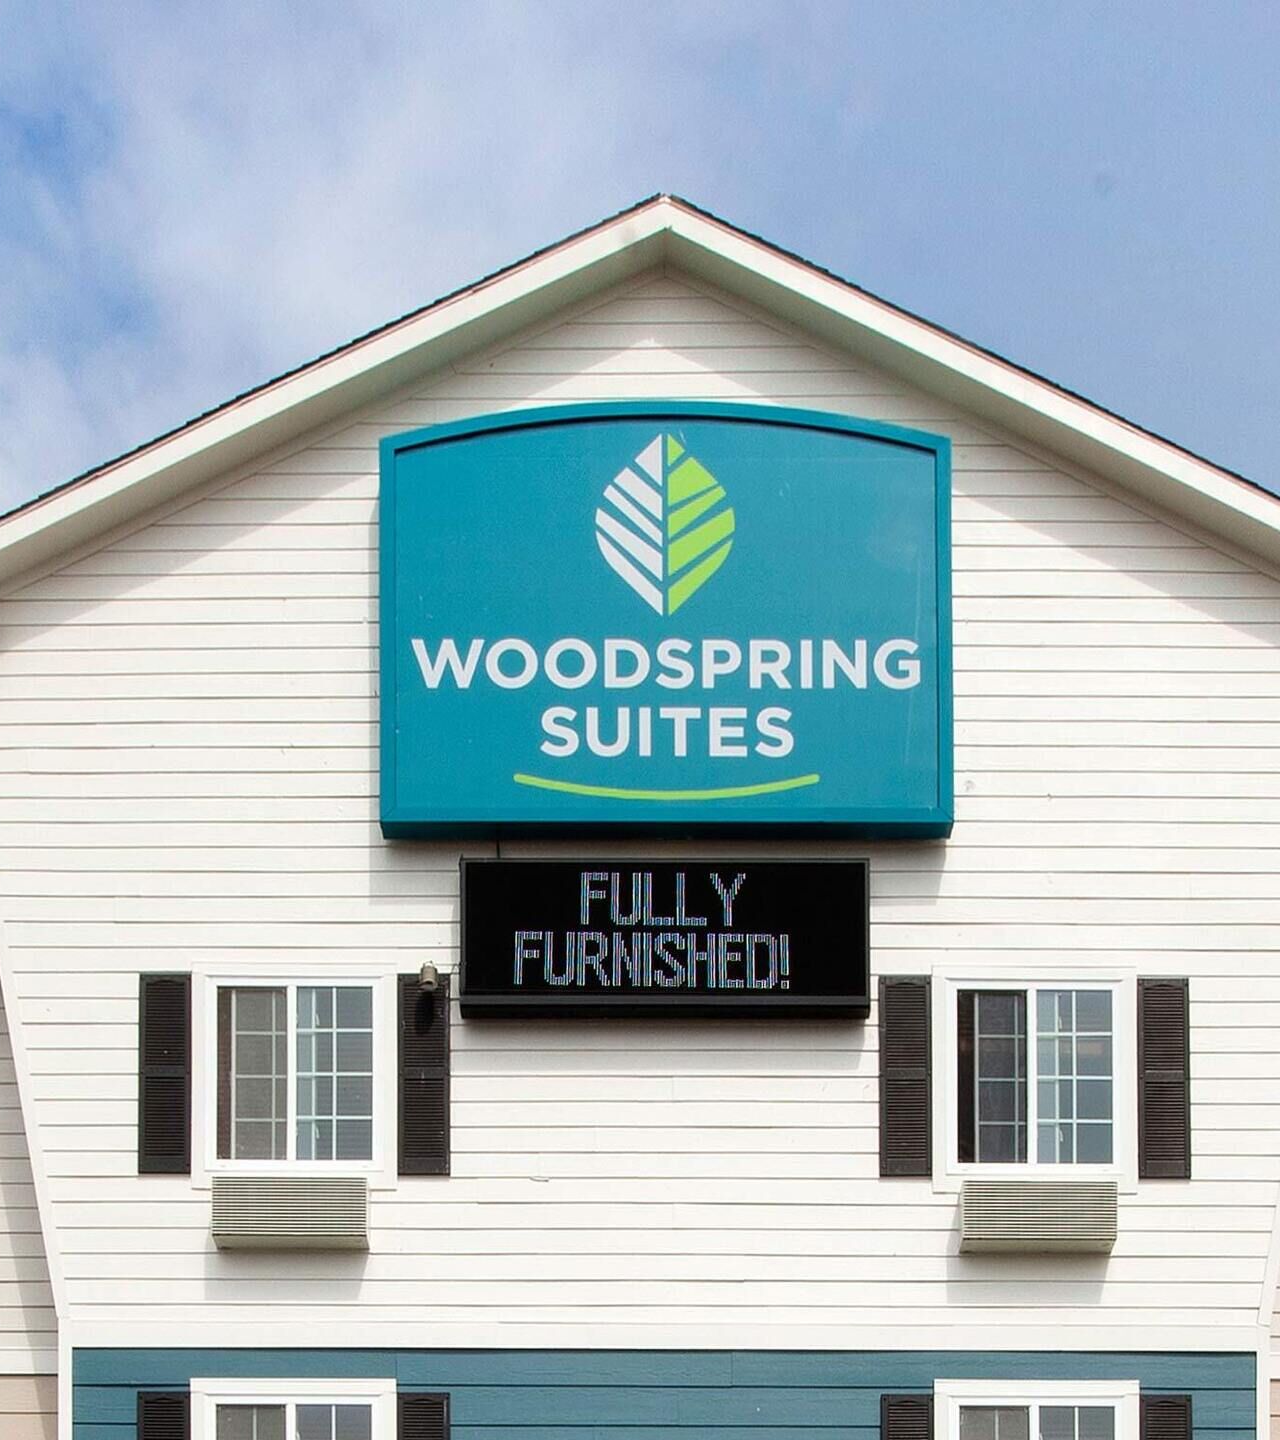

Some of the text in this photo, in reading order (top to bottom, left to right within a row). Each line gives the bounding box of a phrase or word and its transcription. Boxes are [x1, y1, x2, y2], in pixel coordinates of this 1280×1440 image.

[411, 638, 921, 690] WOODSPRING
[539, 706, 794, 758] SUITES
[580, 872, 746, 926] FULLY
[513, 931, 789, 990] FURNISHED!
